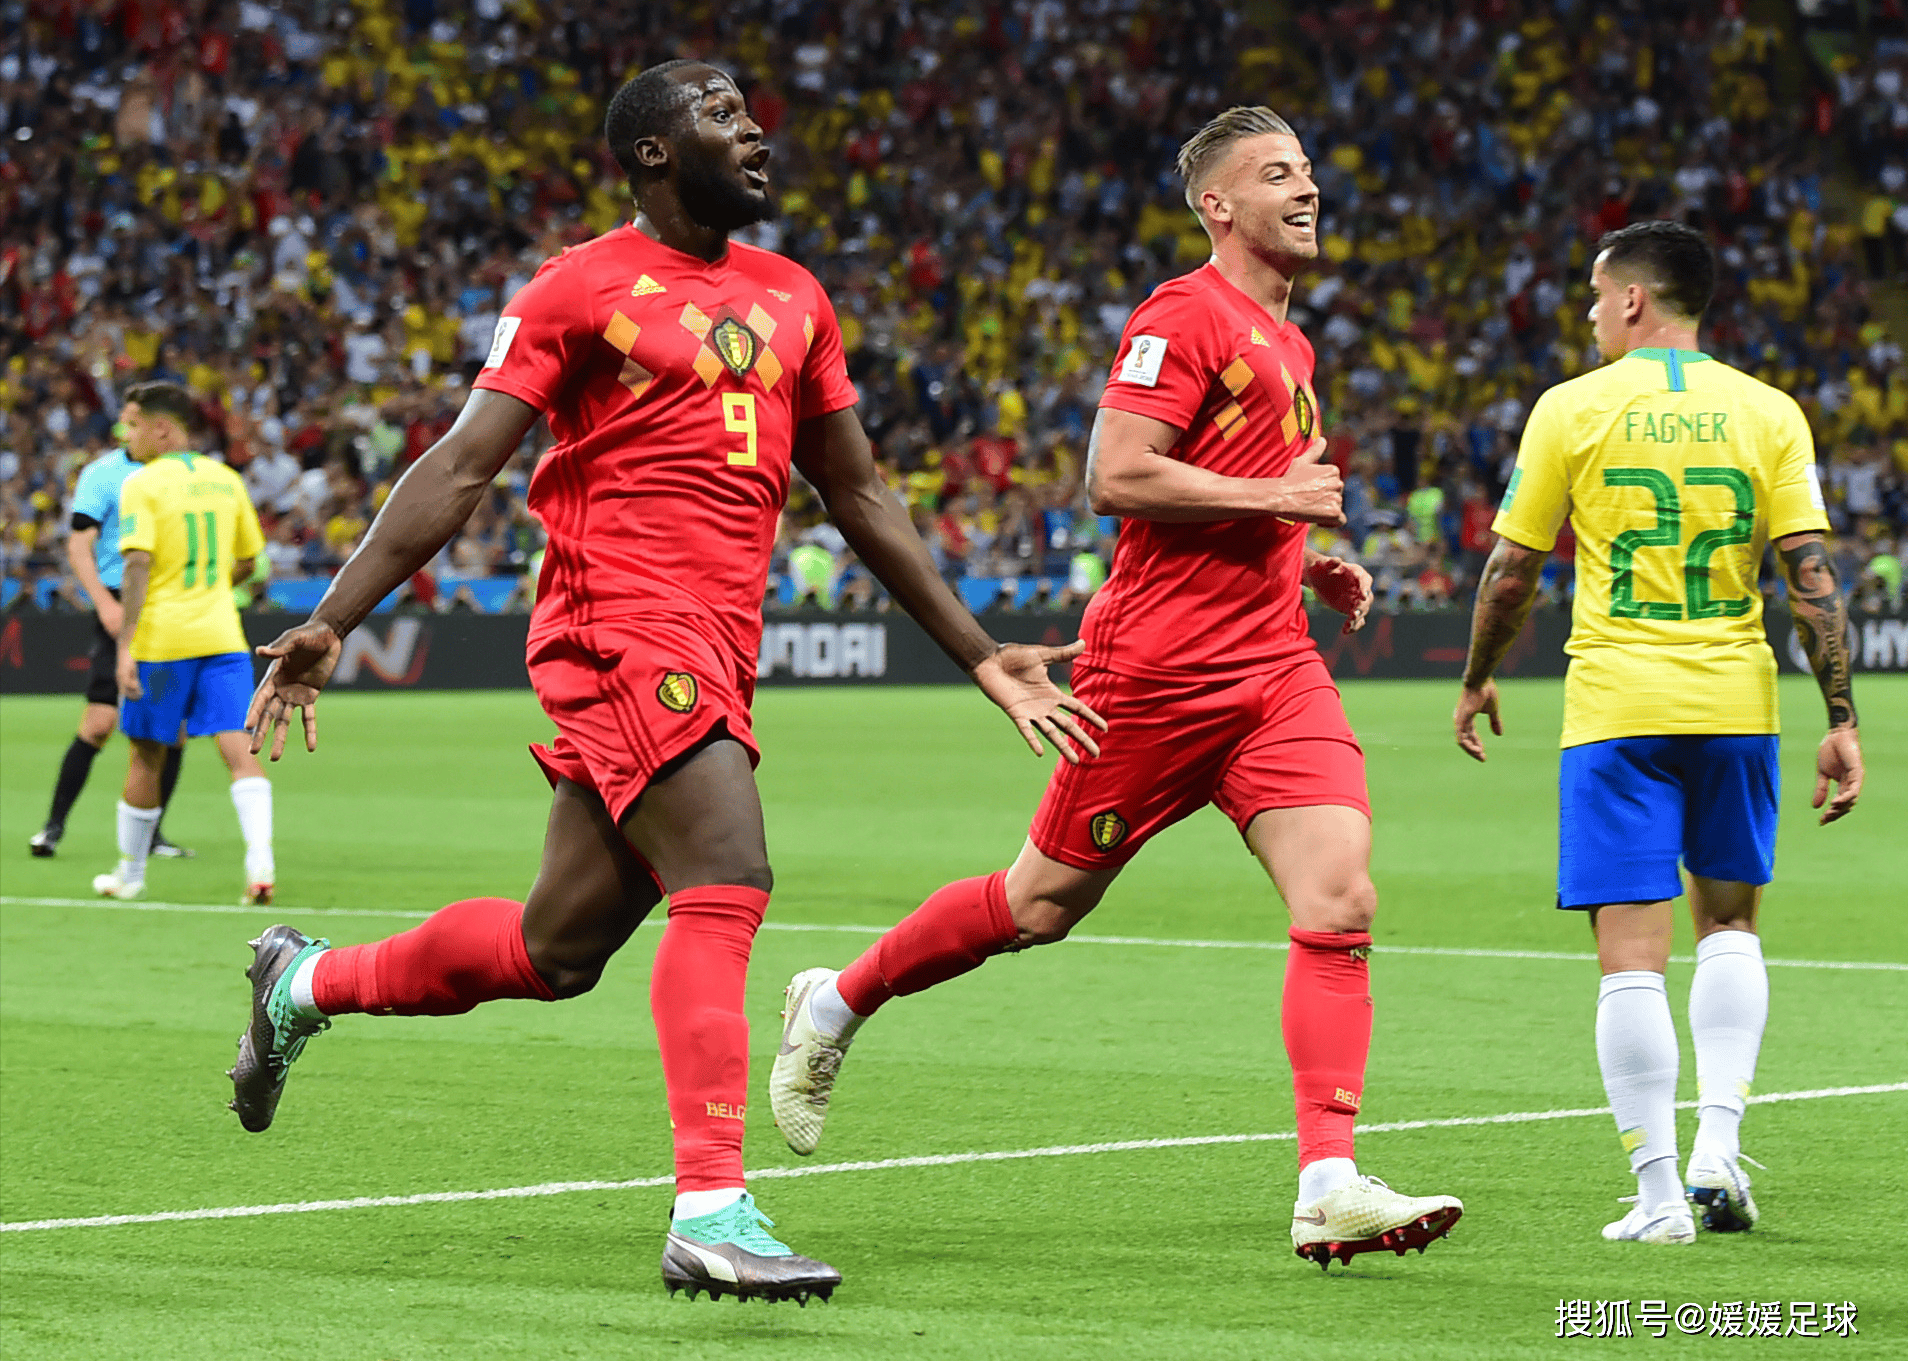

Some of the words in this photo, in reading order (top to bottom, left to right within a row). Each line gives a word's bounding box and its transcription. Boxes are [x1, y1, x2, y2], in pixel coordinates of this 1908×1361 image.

[631, 286, 667, 297] adidas
[722, 392, 758, 466] 9
[1625, 411, 1728, 443] FAGNER
[183, 510, 218, 590] 11
[1602, 466, 1756, 620] 22
